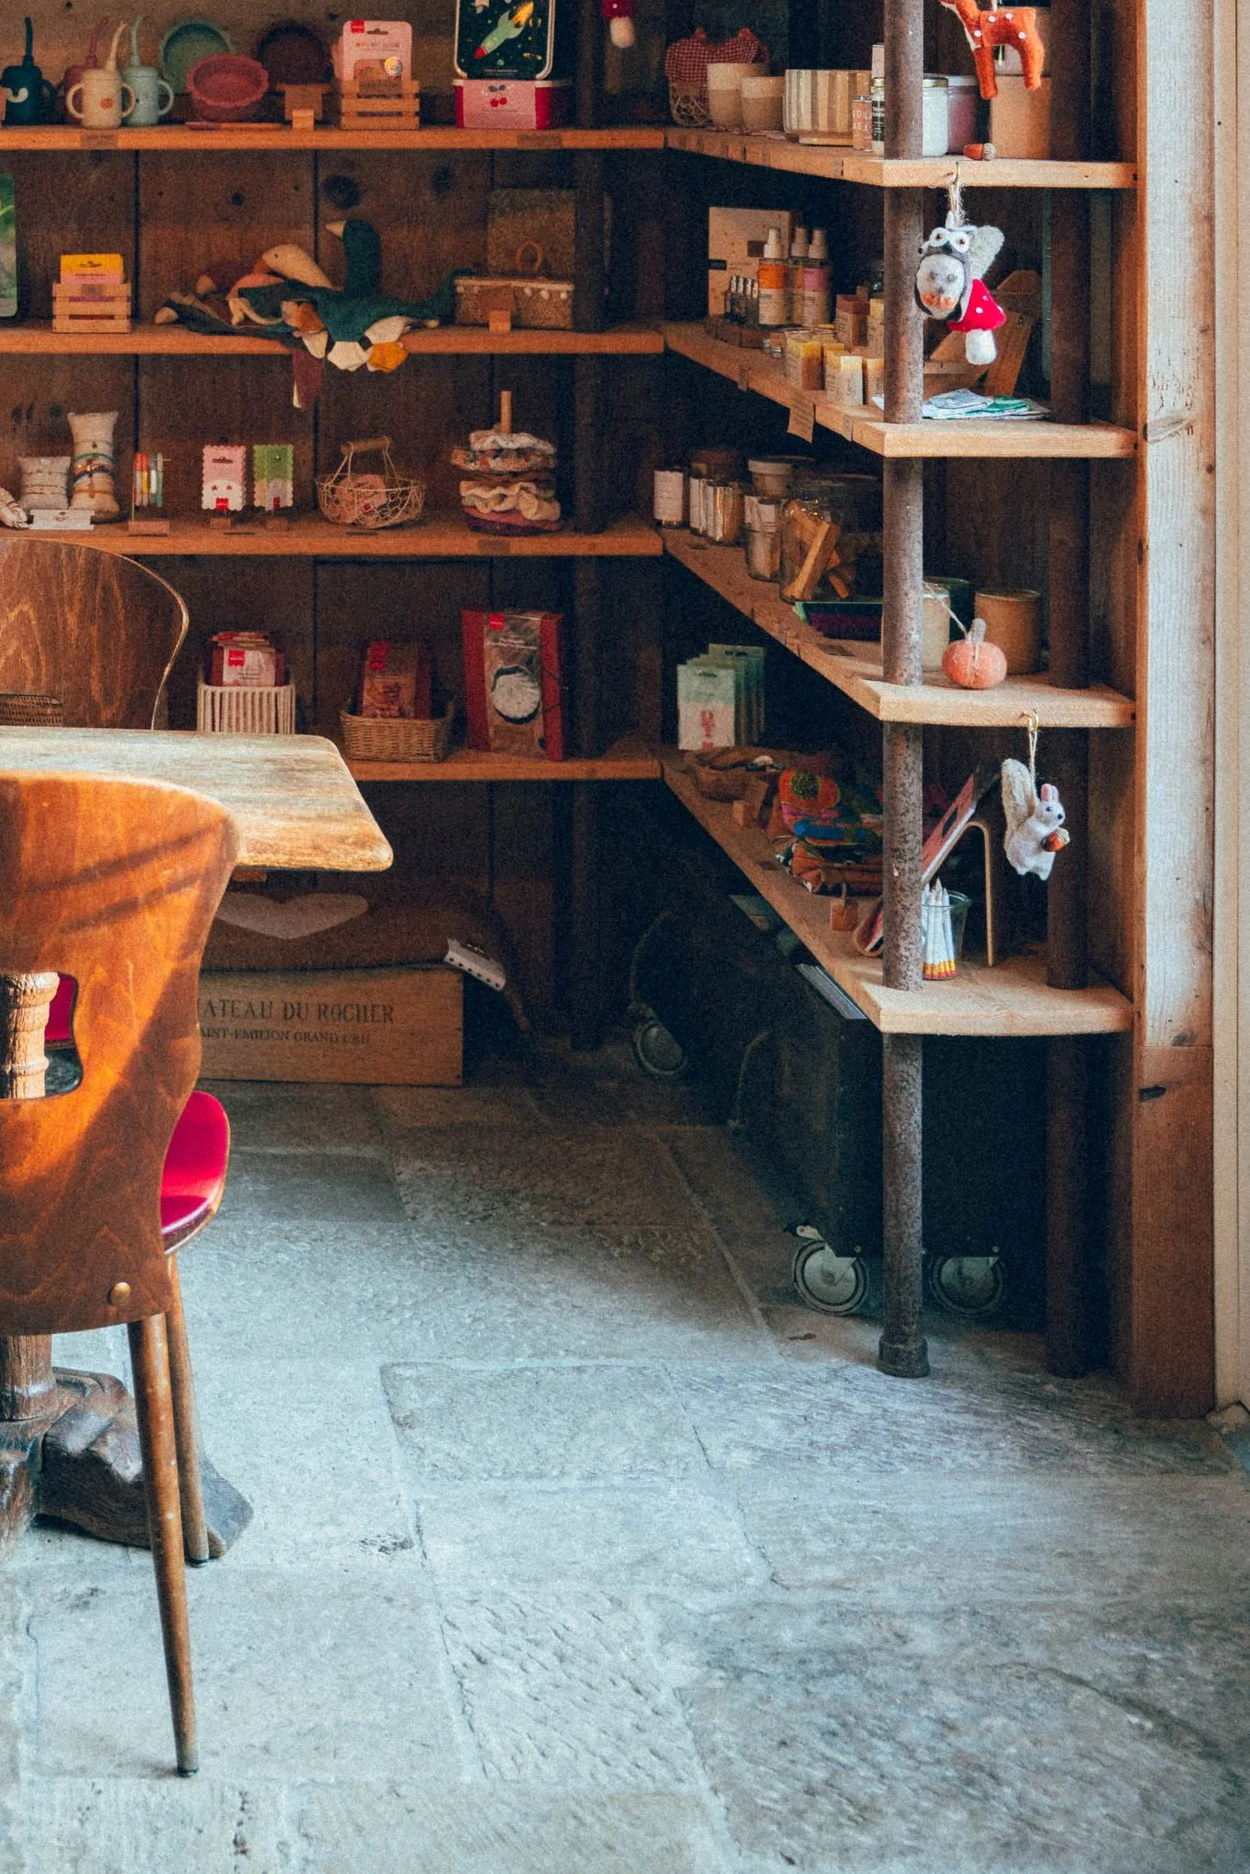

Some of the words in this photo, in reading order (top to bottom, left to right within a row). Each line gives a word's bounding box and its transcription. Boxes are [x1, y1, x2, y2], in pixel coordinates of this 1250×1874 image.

[198, 997, 273, 1020] ATEAU
[281, 999, 310, 1023] DU
[316, 1002, 395, 1024] ROCHER
[200, 1027, 291, 1042] AINT-EMILION
[293, 1030, 340, 1044] GRAND
